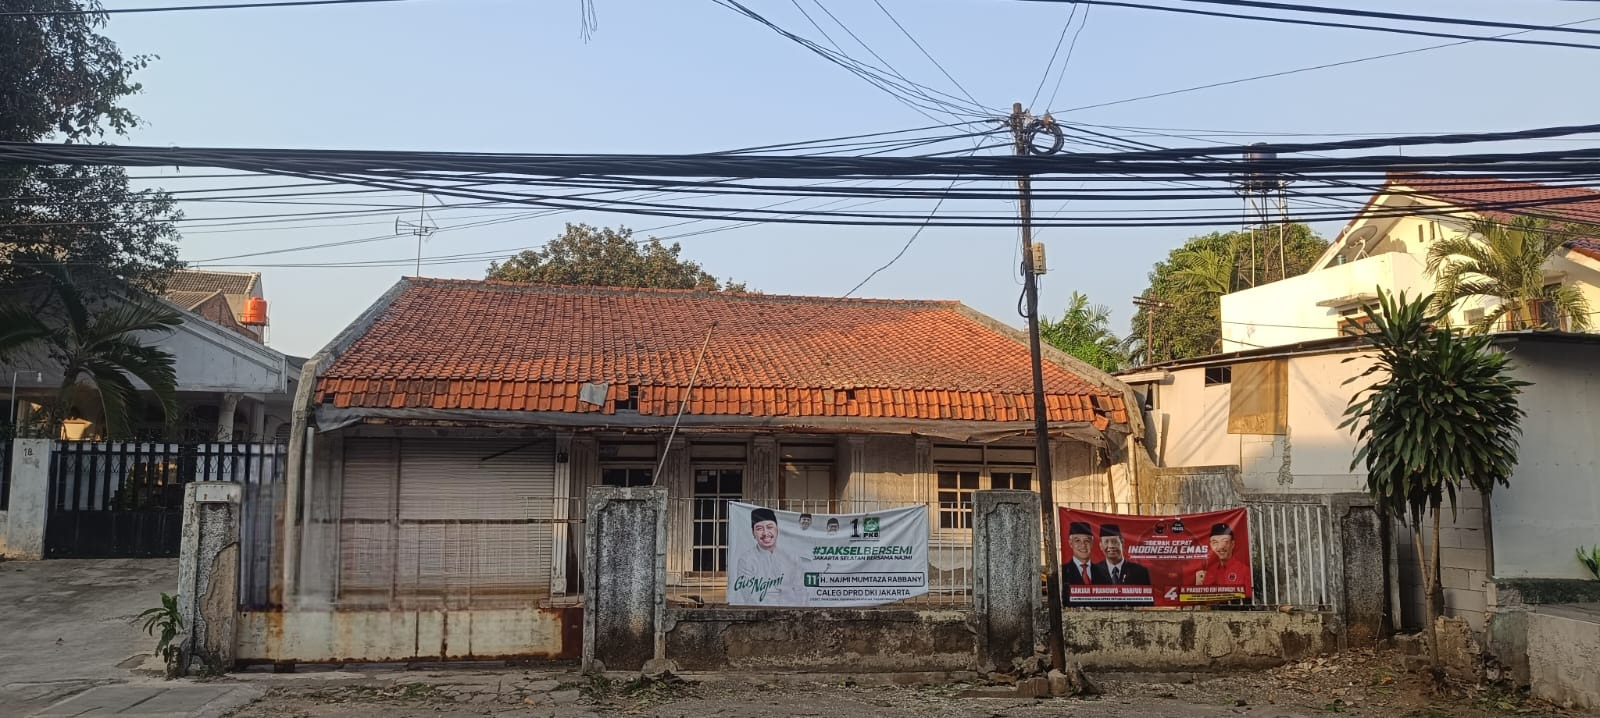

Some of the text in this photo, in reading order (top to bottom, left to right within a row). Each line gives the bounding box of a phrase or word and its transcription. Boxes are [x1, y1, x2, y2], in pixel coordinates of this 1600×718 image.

[851, 518, 860, 538] 1
[812, 545, 913, 556] #JAKSELBERSEMI
[1127, 545, 1209, 554] INDONESIA EMAS
[806, 574, 817, 585] 11
[820, 576, 828, 584] H.
[734, 573, 785, 602] Gus Najmi
[1164, 586, 1178, 600] 4
